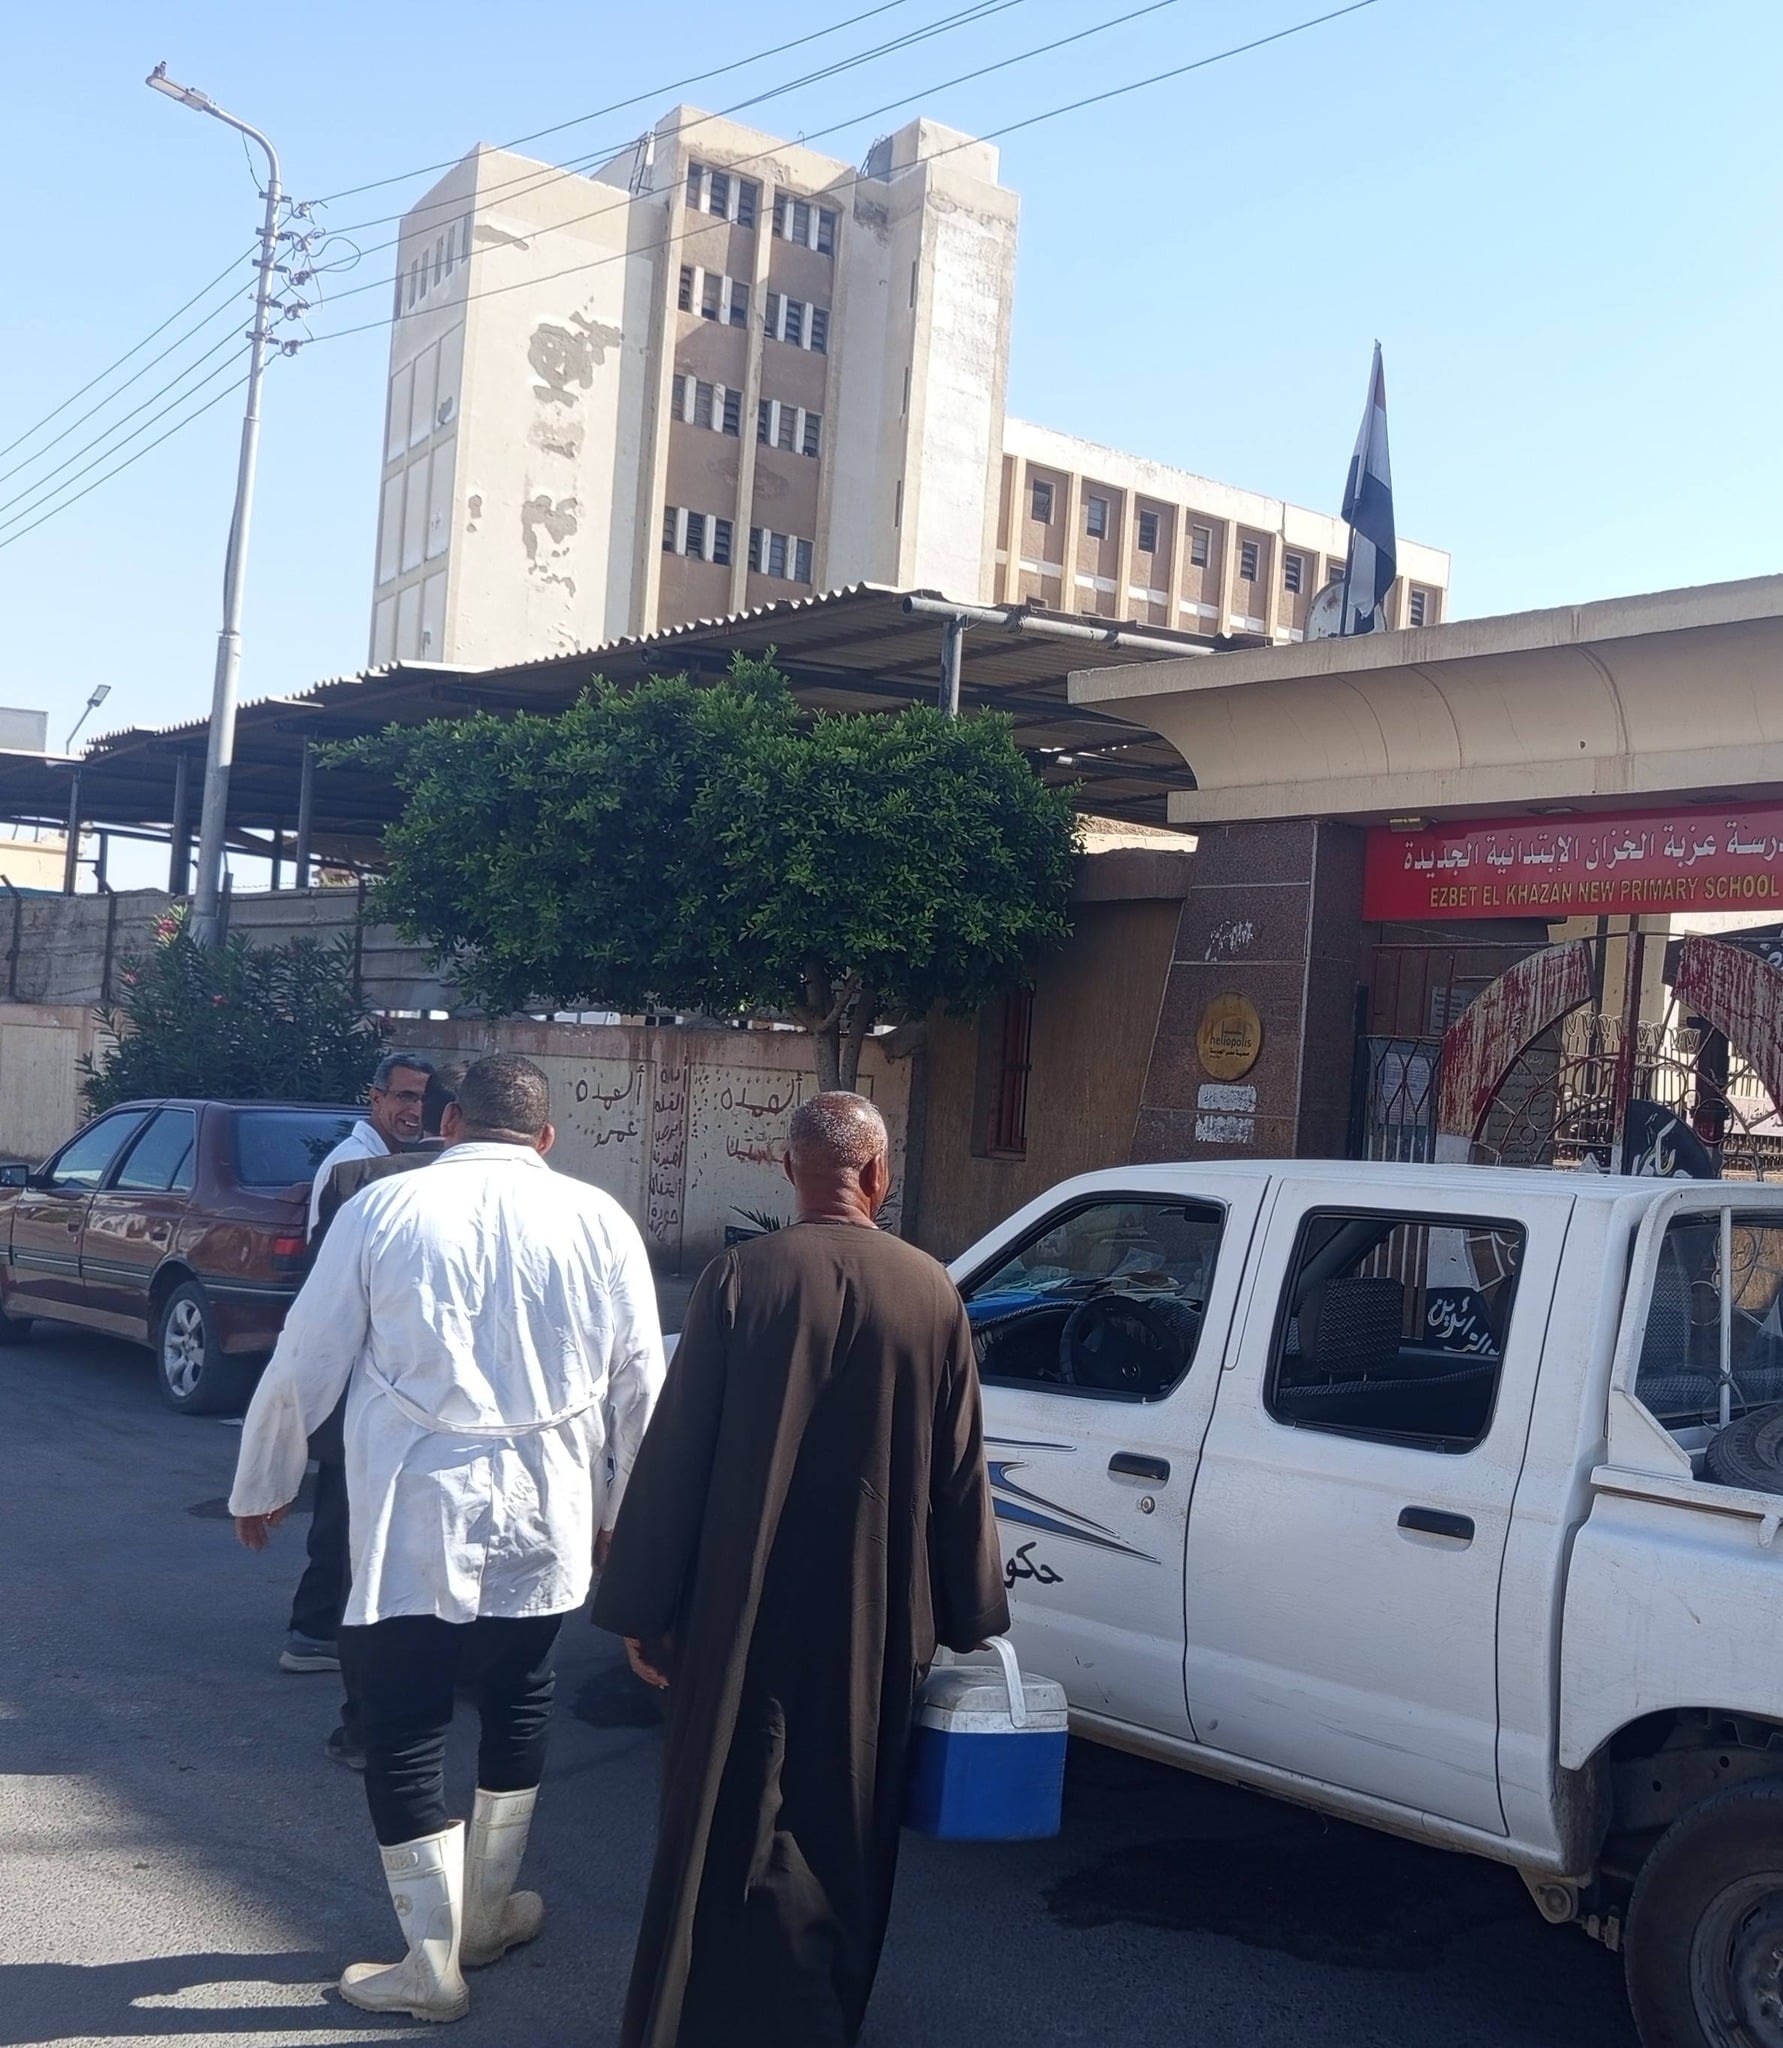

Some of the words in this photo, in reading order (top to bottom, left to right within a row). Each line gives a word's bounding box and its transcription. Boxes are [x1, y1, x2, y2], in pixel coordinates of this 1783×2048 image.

[1403, 841, 1479, 879] الجديدة
[1585, 829, 1655, 871] الخزان
[1663, 824, 1718, 868] عزبة
[1726, 820, 1783, 862] رسة
[1430, 886, 1477, 908] EZBET
[1483, 885, 1500, 906] EL
[1506, 881, 1572, 905] KHAZAN
[1578, 878, 1616, 904] NEW
[1620, 876, 1699, 902] PRIMARY
[1705, 873, 1780, 900] SCHOOL
[1209, 1023, 1251, 1049] heliopolis
[1003, 1541, 1064, 1589] حكو
